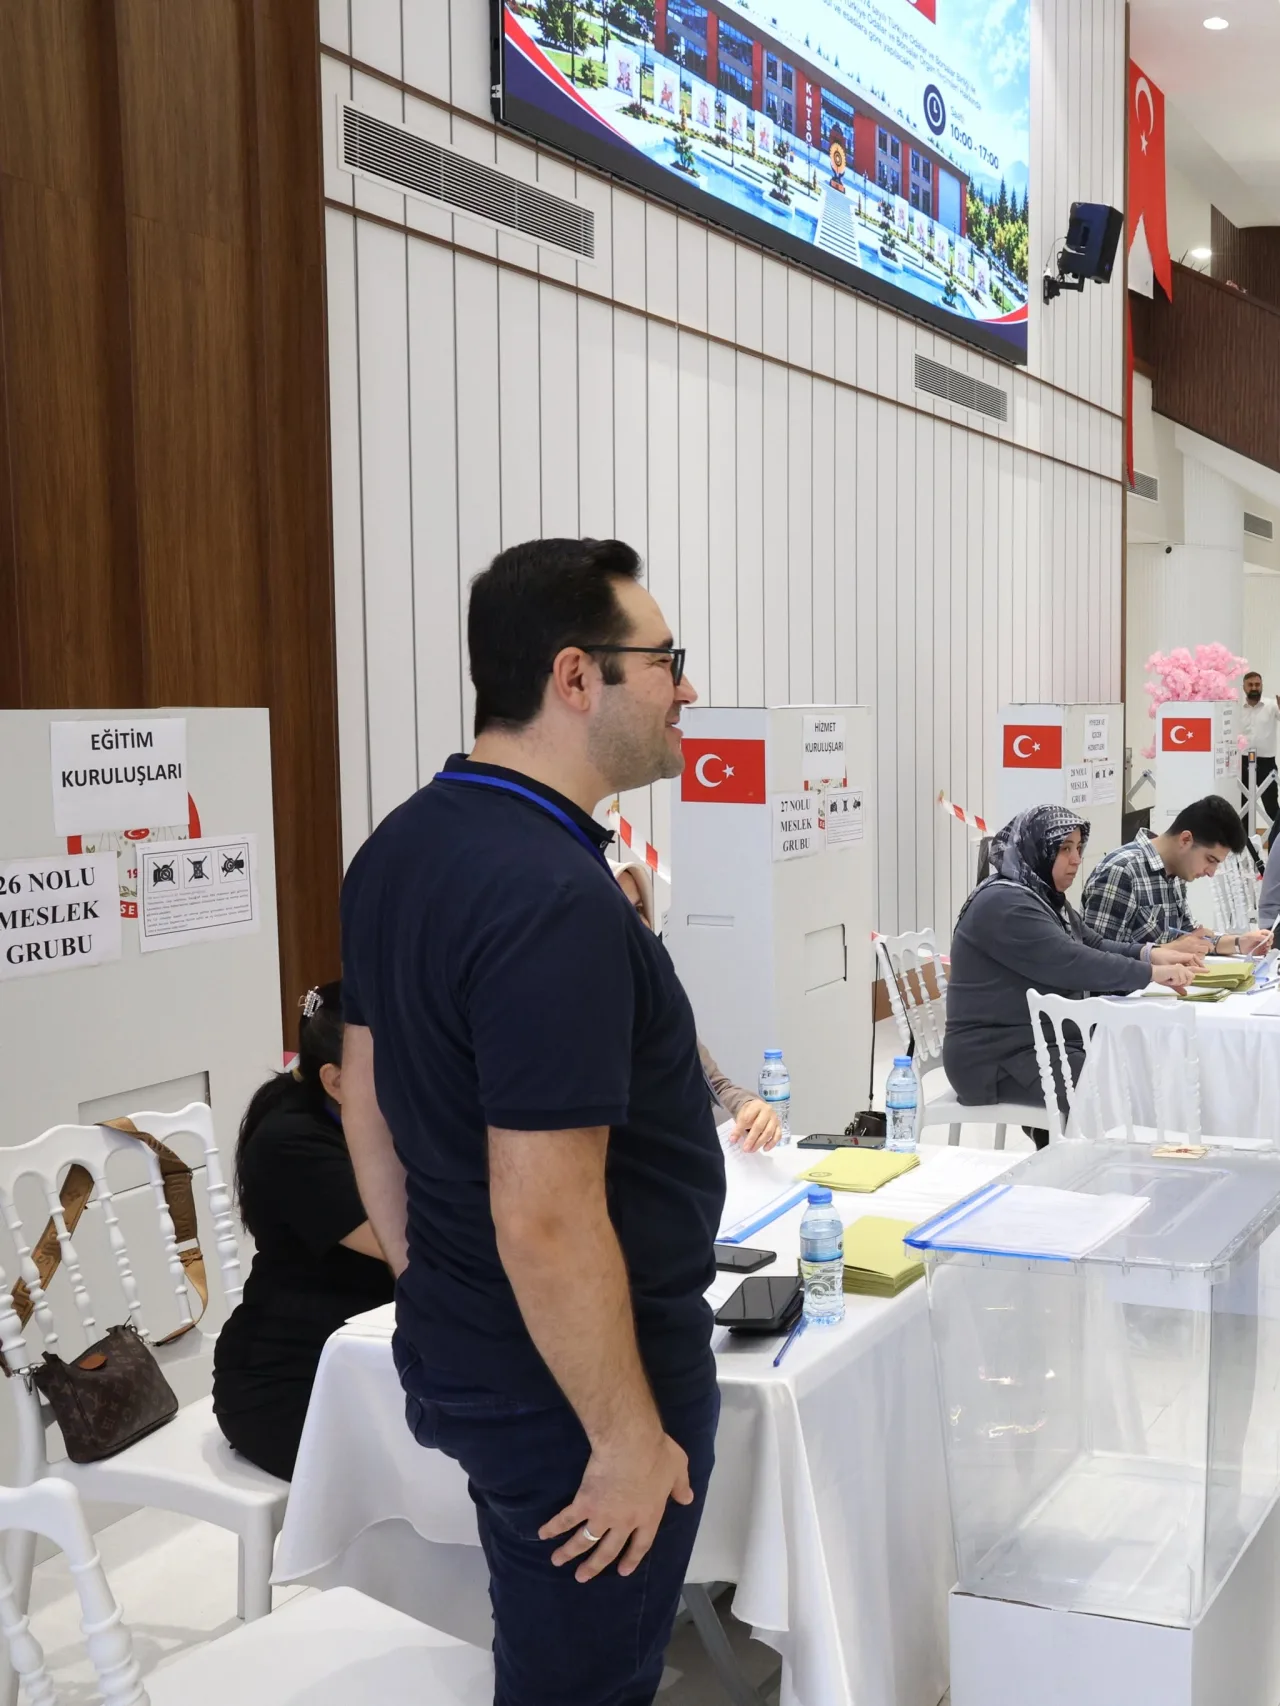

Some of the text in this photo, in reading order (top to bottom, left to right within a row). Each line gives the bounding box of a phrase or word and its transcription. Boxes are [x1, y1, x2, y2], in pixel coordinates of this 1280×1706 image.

[805, 82, 813, 143] KMTSO
[950, 123, 973, 150] 10:00
[979, 144, 999, 170] 17:00
[814, 720, 836, 732] HİZMET
[91, 728, 153, 750] EĞİTİM
[805, 742, 844, 754] KURULUŞLARI
[62, 763, 182, 787] KURULUŞLARI
[1070, 780, 1088, 790] MESLEK
[781, 799, 811, 812] 27 NOLU
[780, 818, 812, 832] MESLEK
[783, 838, 810, 852] GRUBU
[28, 867, 95, 893] NOLU
[0, 900, 100, 930] MESLEK
[6, 934, 92, 964] GRUBU
